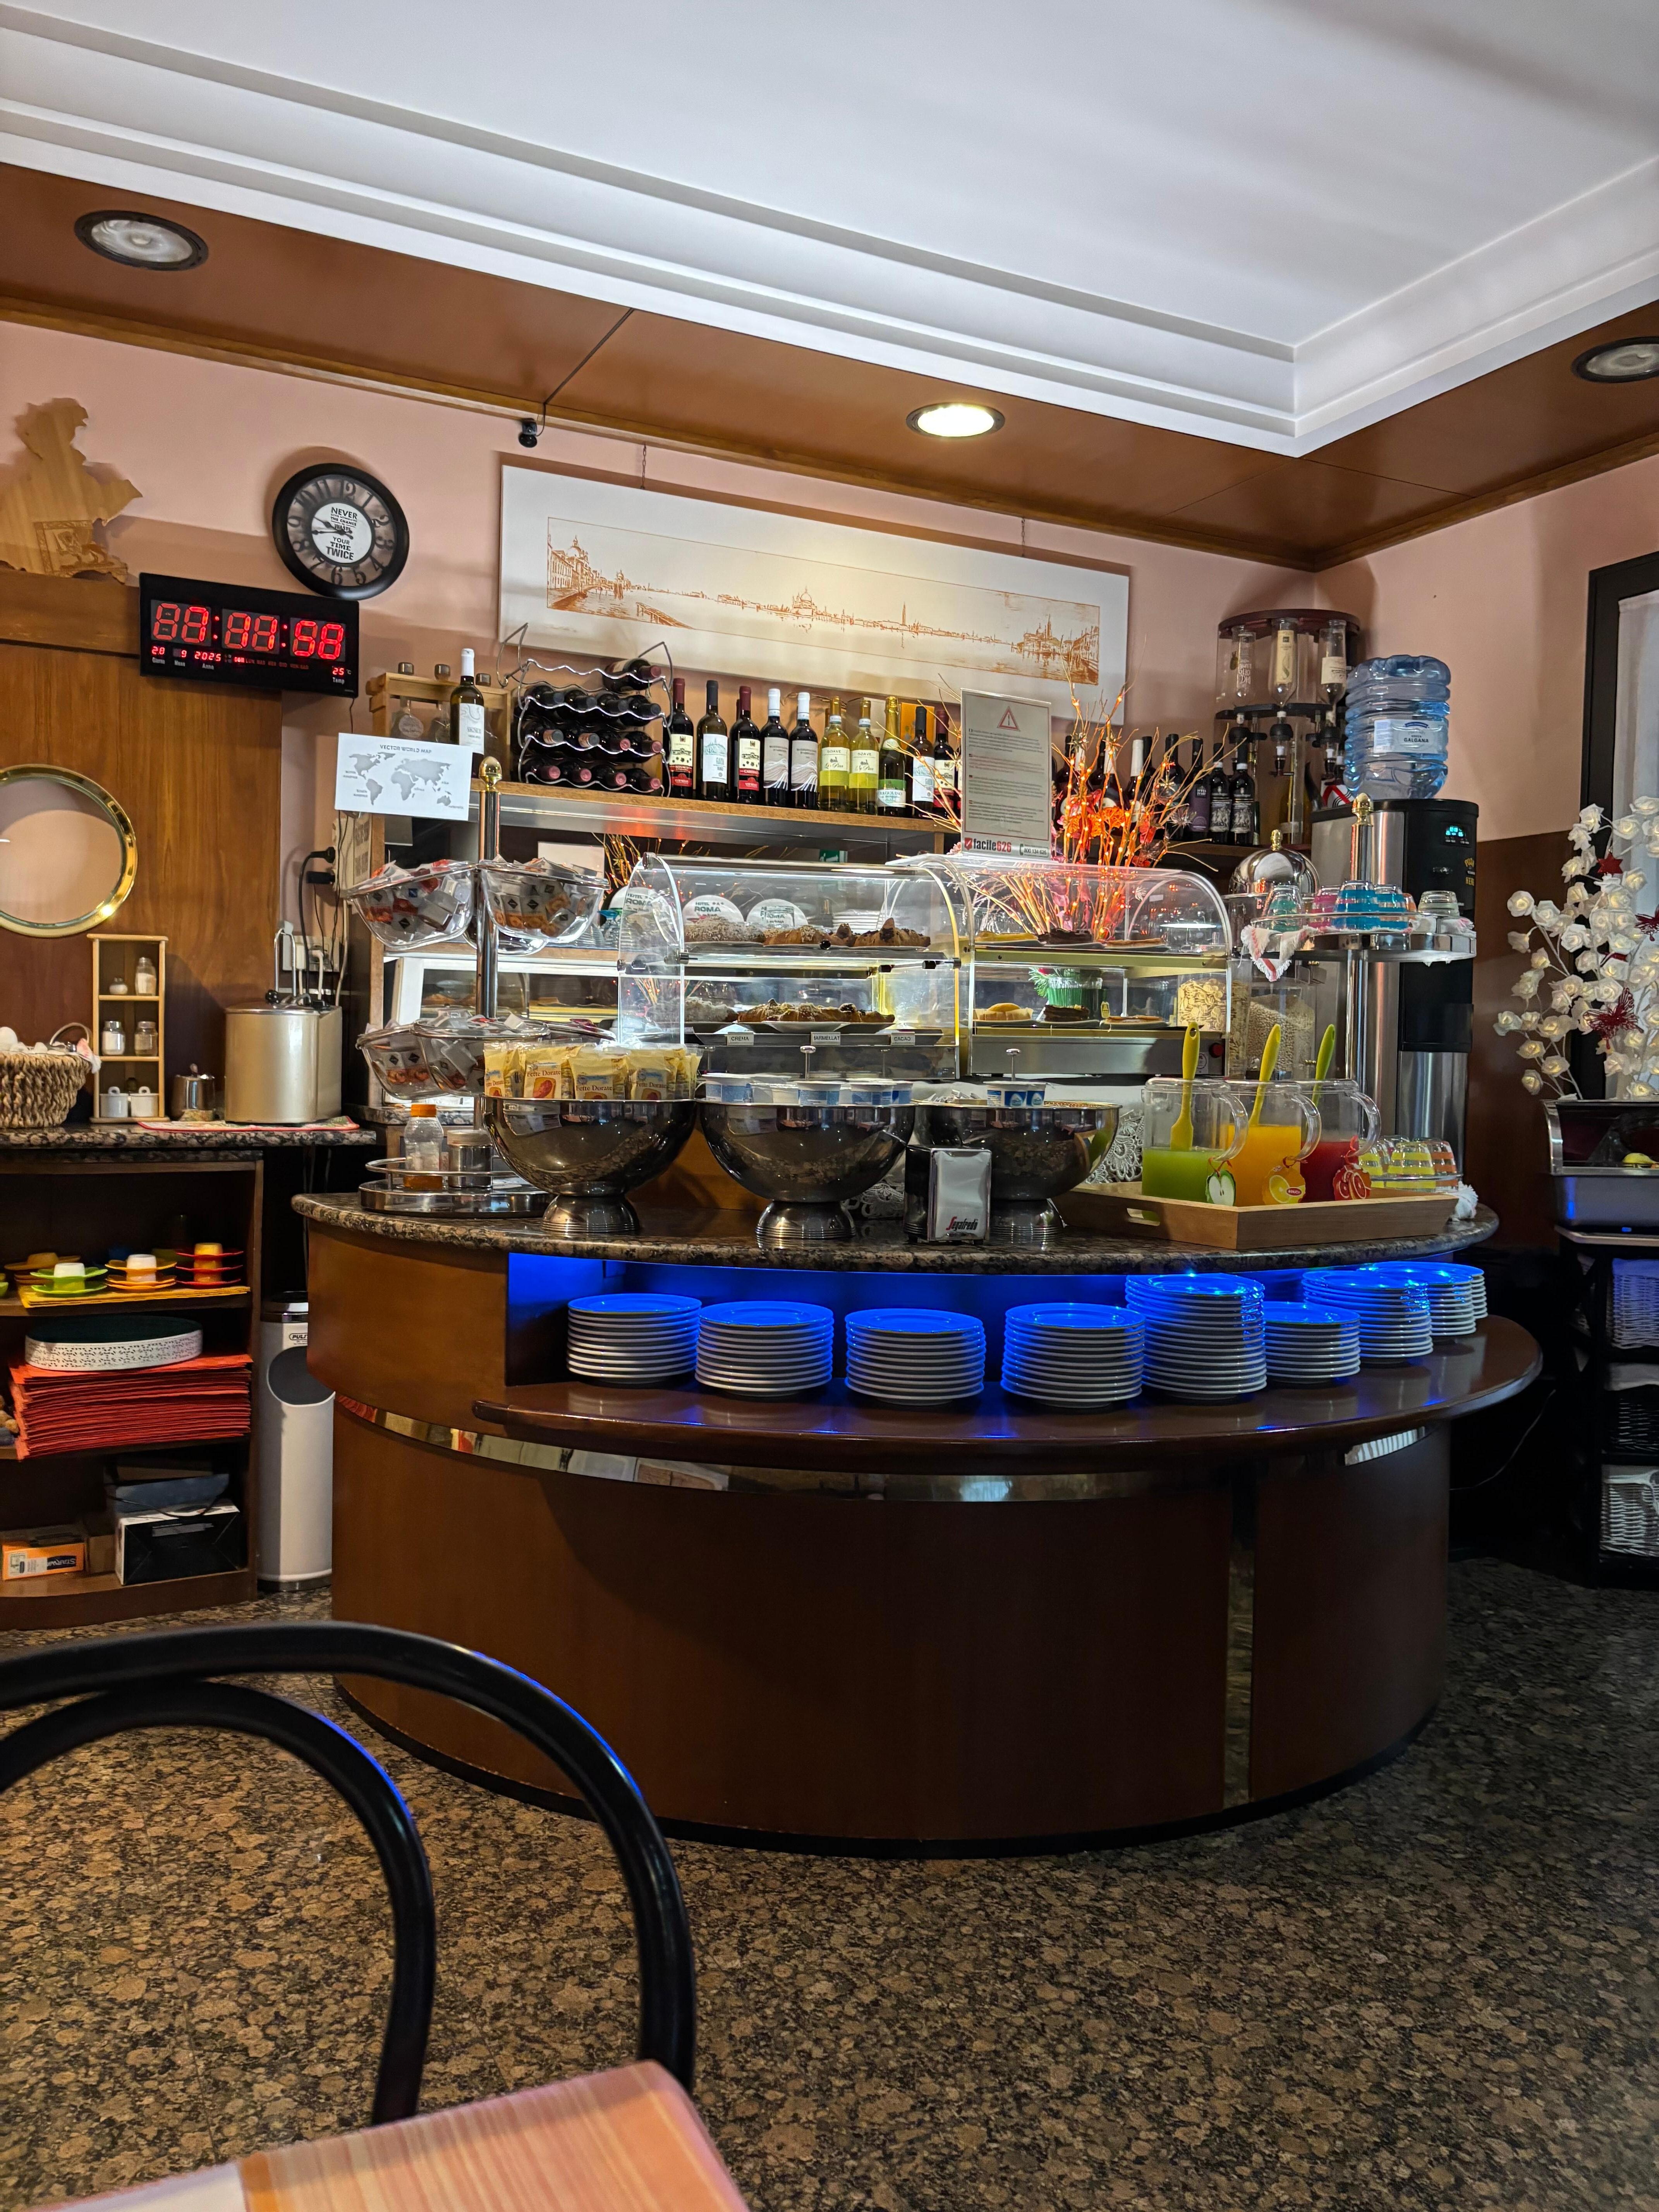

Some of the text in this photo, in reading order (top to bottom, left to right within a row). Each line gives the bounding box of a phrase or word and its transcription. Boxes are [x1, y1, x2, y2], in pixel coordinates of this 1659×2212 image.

[362, 491, 373, 508] 1
[331, 507, 357, 519] NEVER
[372, 515, 389, 527] 2
[330, 541, 351, 551] TIME
[333, 536, 350, 545] YOUR
[326, 546, 354, 560] TWICE
[331, 566, 343, 585] 6
[353, 568, 366, 585] 5
[151, 646, 165, 655] 28
[194, 651, 221, 661] 2025
[332, 667, 344, 675] 25
[973, 838, 1012, 853] facile626
[946, 1216, 979, 1231] Segafredo
